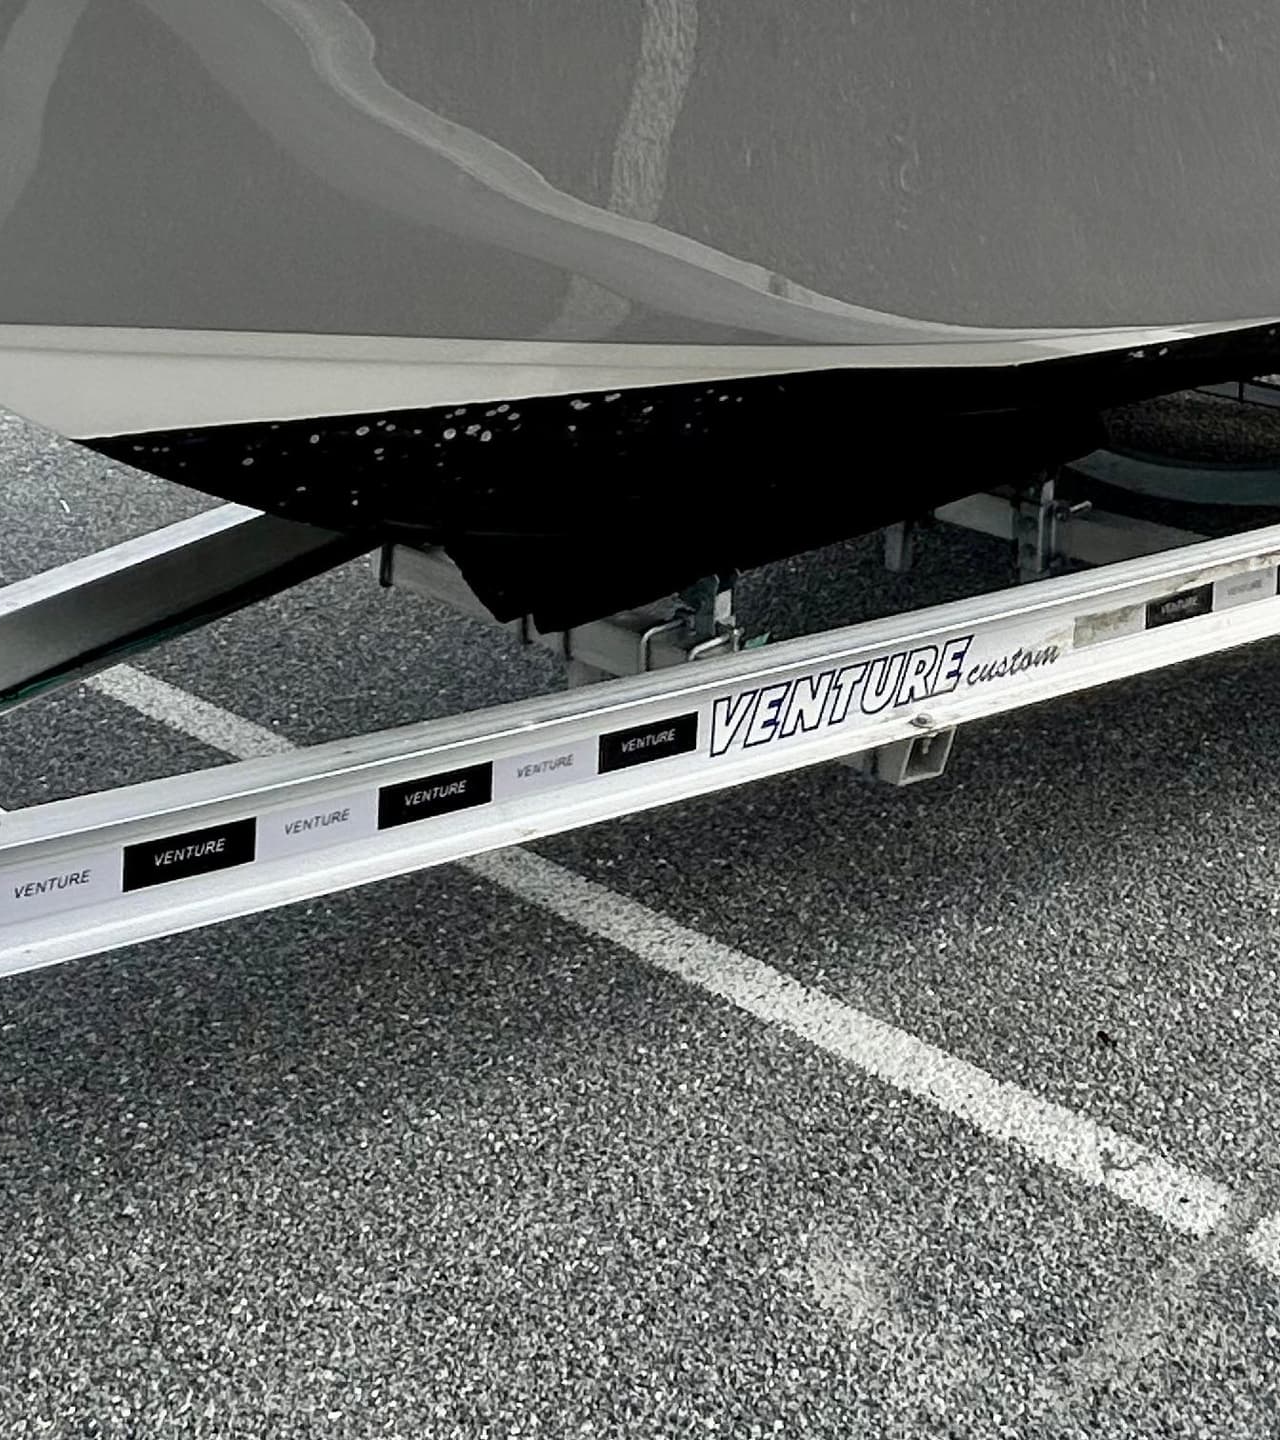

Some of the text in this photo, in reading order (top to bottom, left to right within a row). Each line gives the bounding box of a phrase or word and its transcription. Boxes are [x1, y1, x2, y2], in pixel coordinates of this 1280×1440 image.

[710, 634, 1061, 758] VENTURE custom
[621, 728, 676, 754] VENTURE
[516, 754, 574, 779] VENTURE
[404, 780, 467, 807] VENTURE
[284, 808, 350, 835] VENTURE
[154, 838, 226, 867] VENTURE
[14, 869, 92, 899] VENTURE
